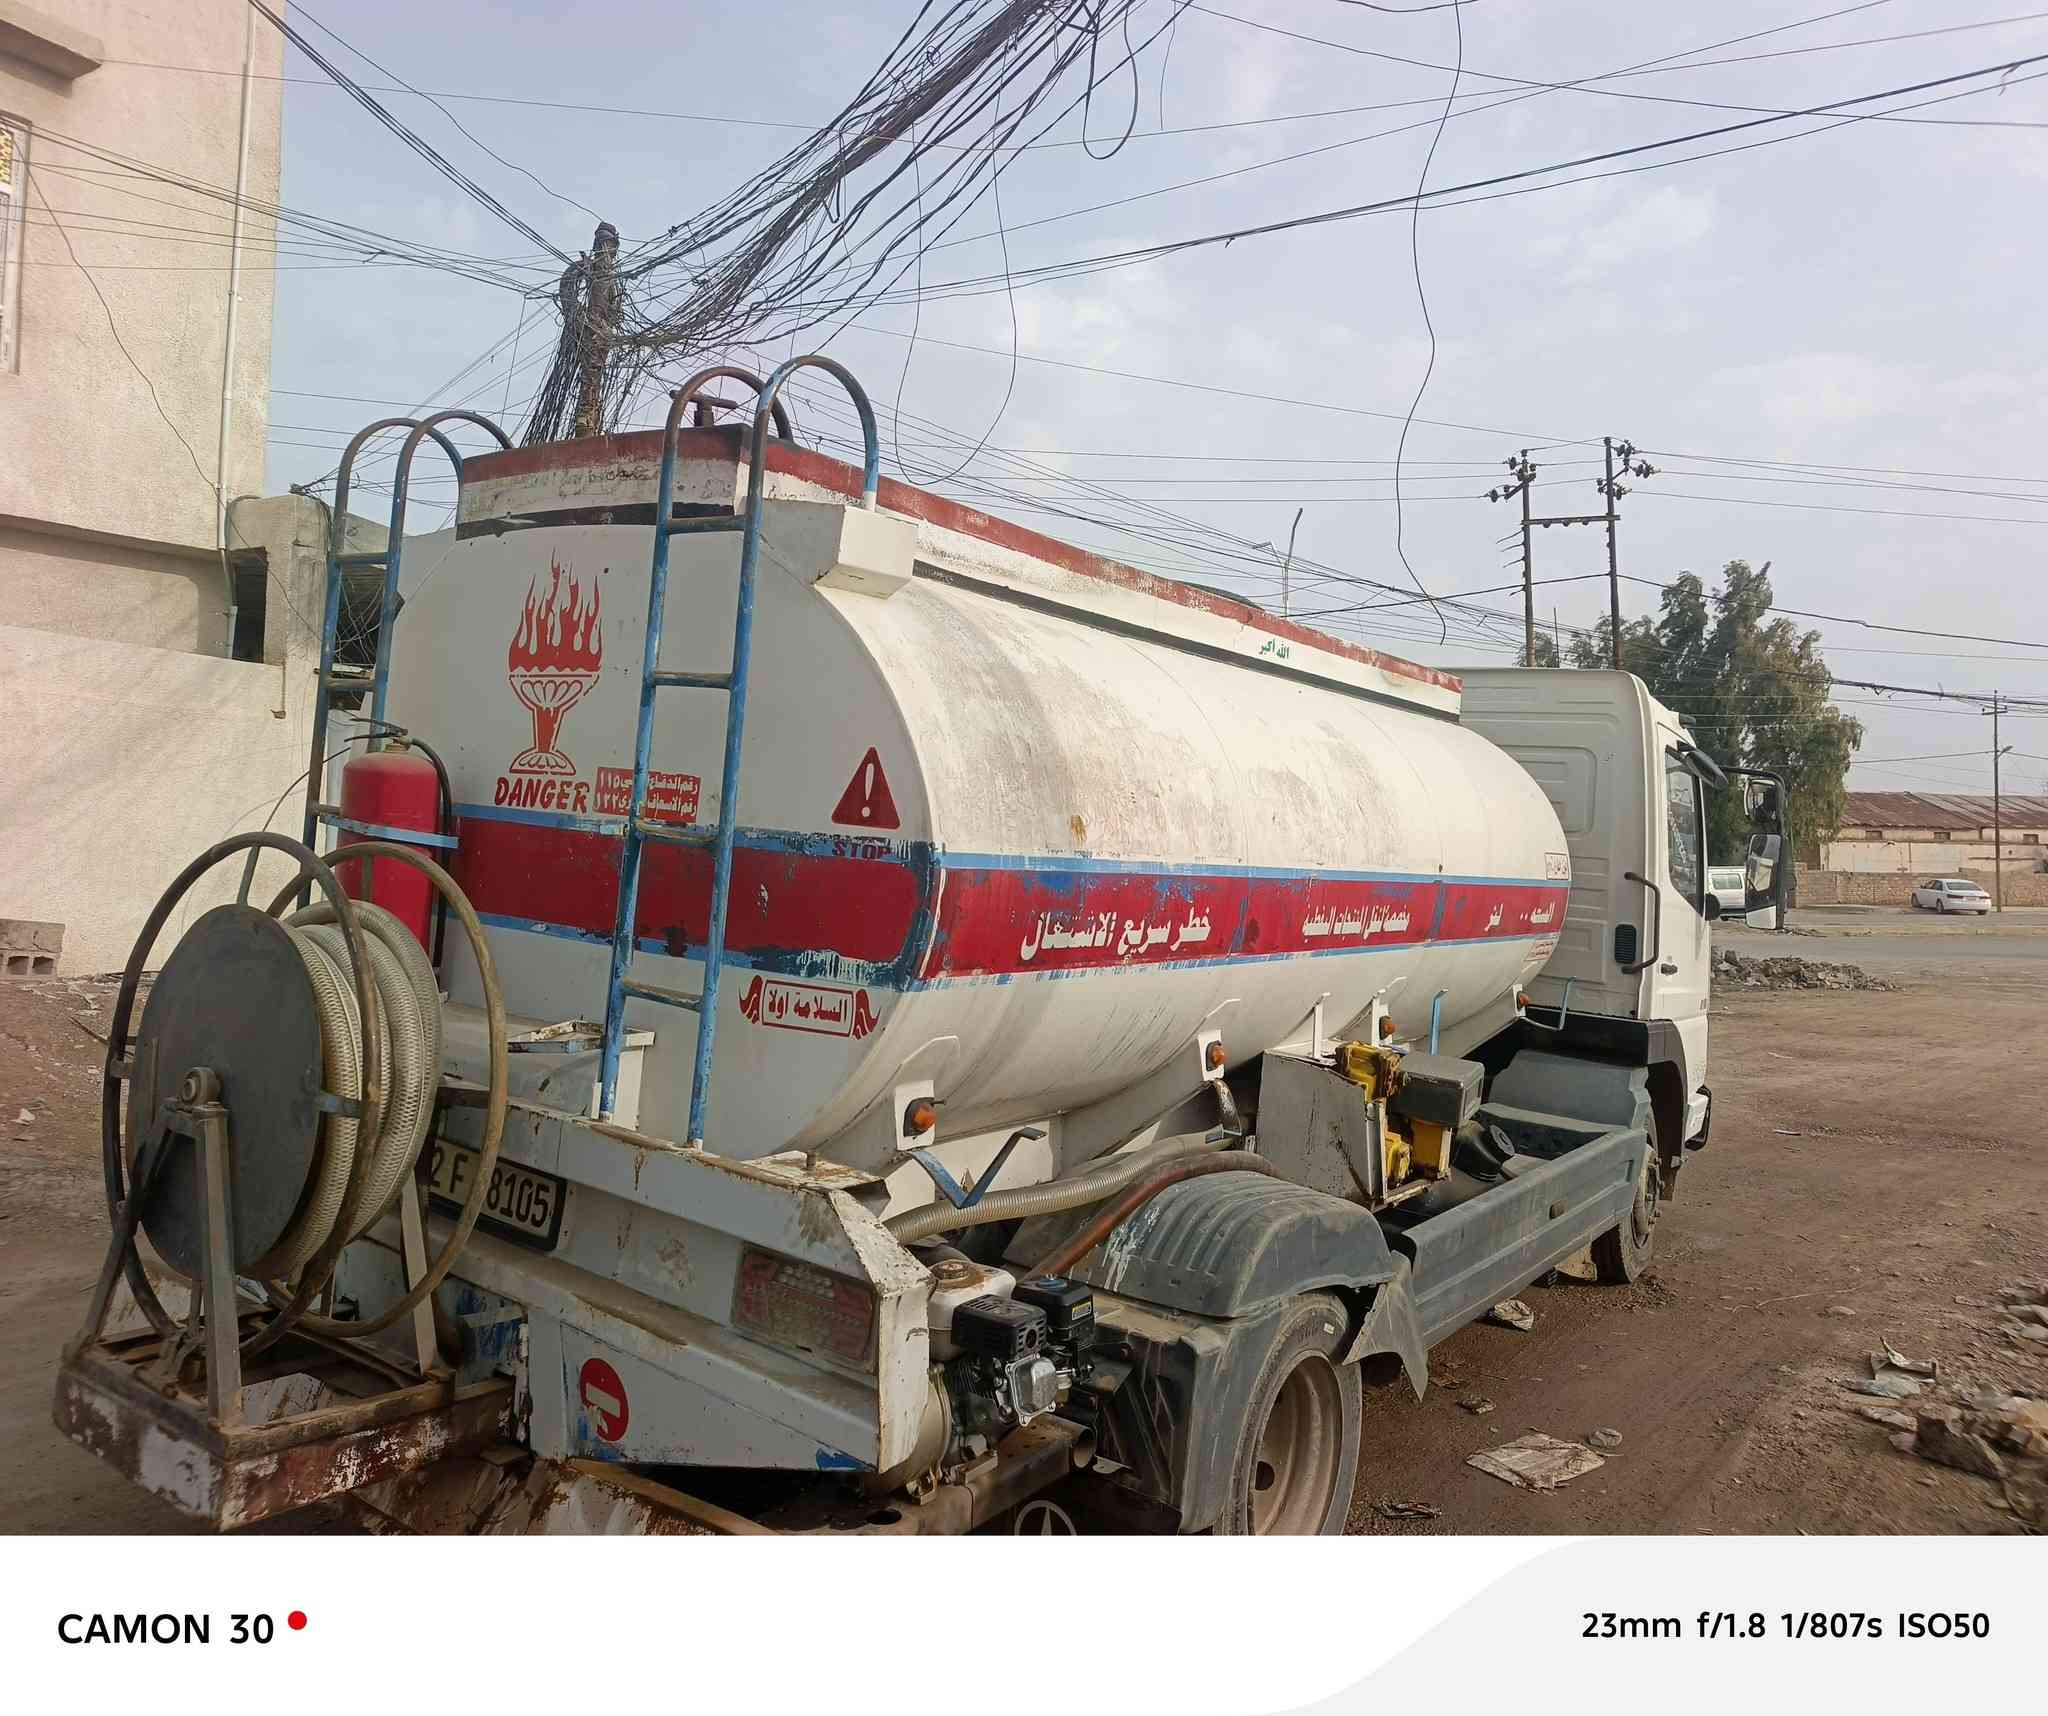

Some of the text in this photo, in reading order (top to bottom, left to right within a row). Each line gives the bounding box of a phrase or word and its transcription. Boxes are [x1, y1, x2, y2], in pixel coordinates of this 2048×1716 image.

[1276, 640, 1290, 659] الله
[495, 776, 590, 814] DANGER
[680, 777, 699, 795] رقم
[680, 798, 698, 817] رقم
[1020, 906, 1212, 961] خطر سريع الاشتعال
[487, 1166, 551, 1228] 8105
